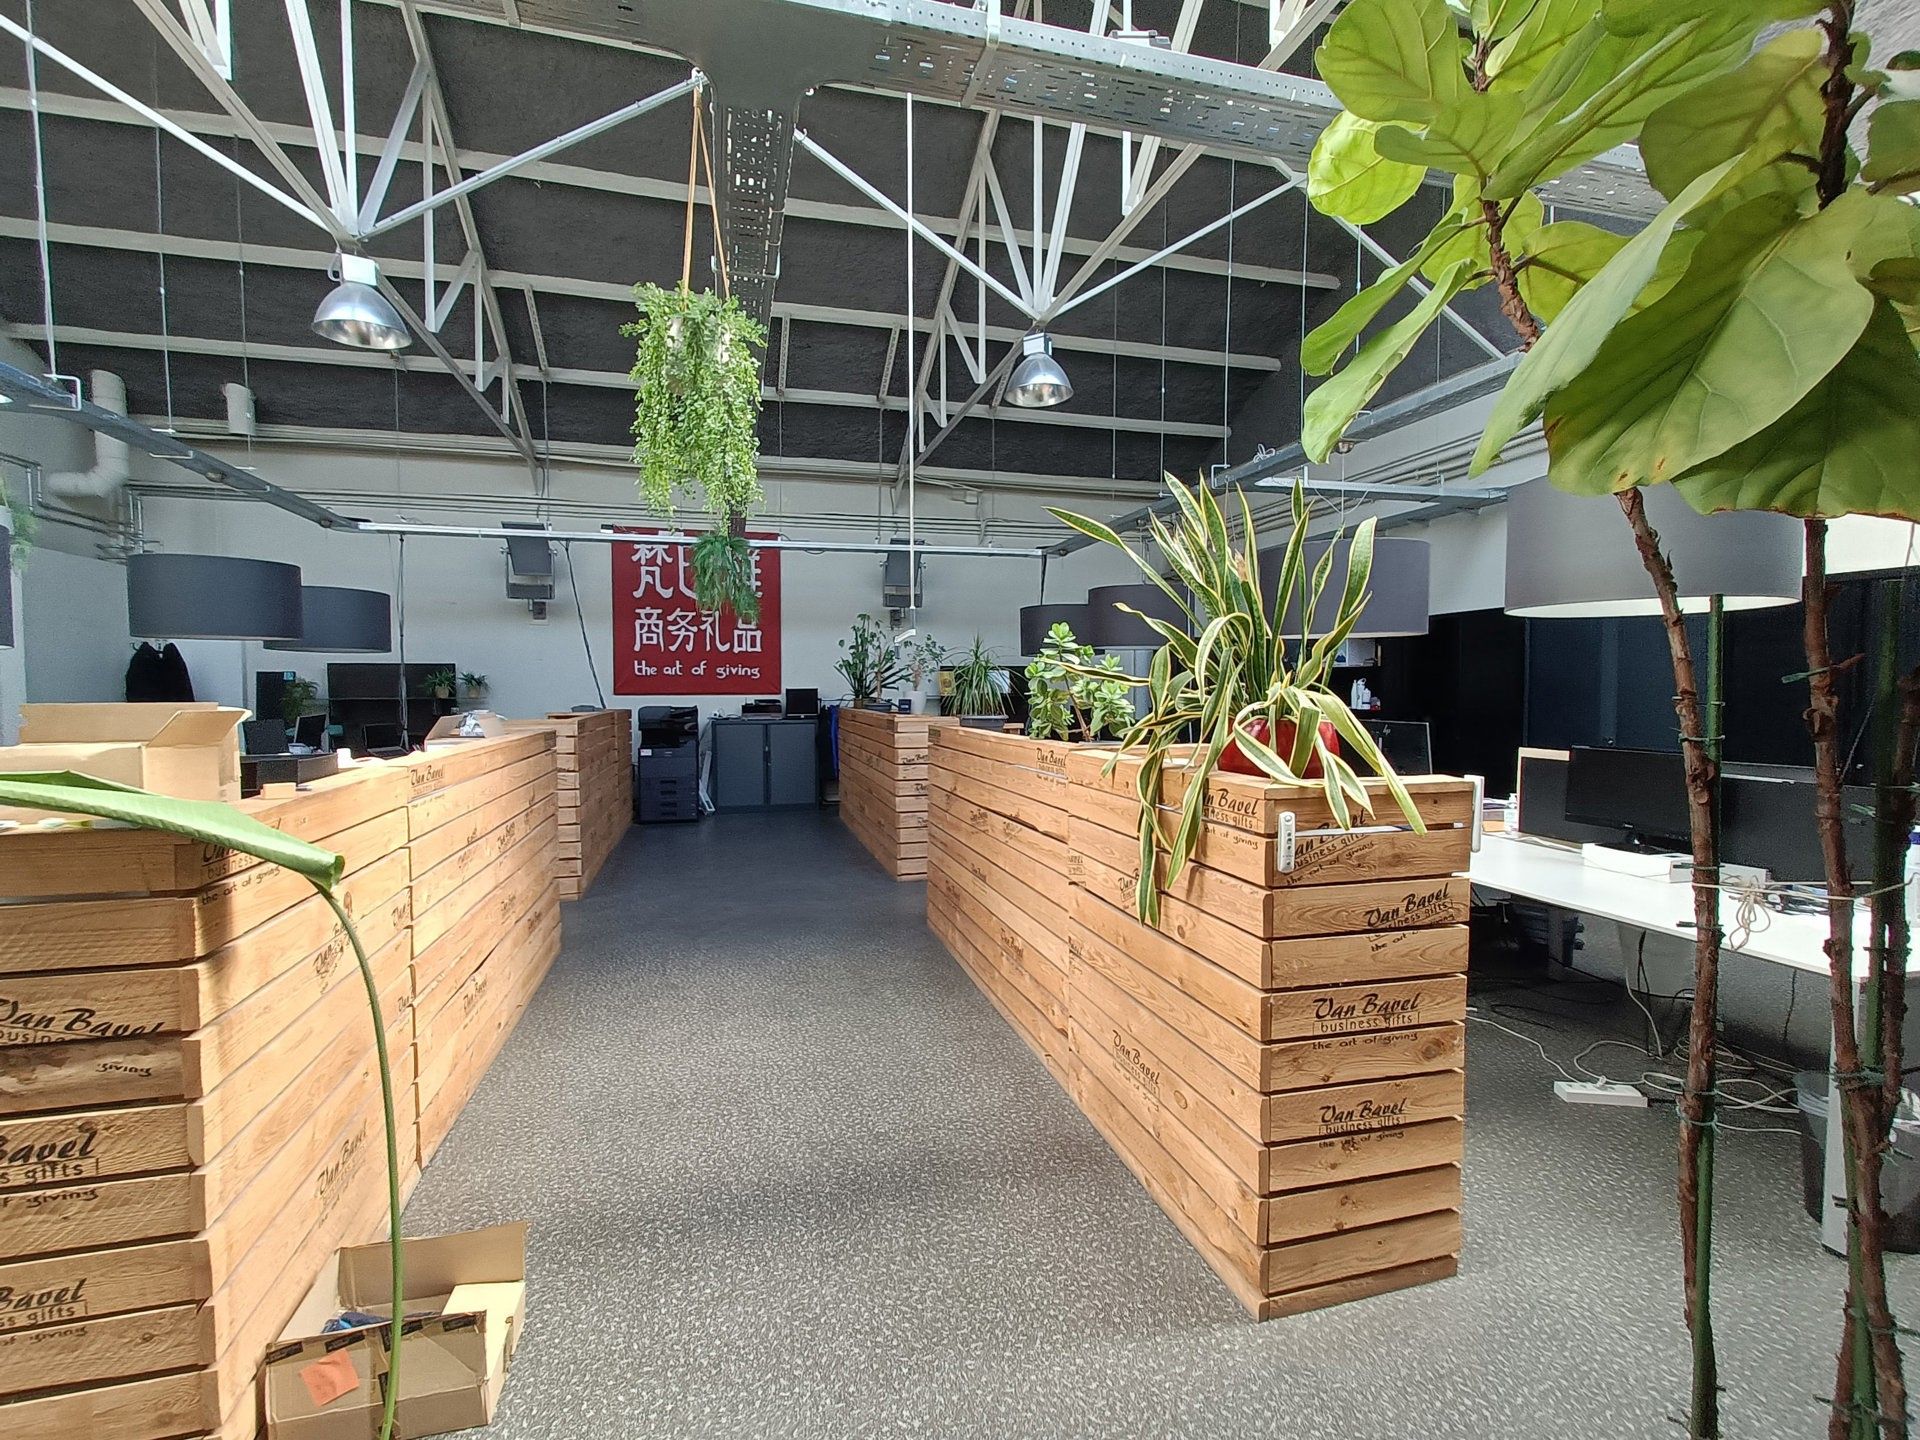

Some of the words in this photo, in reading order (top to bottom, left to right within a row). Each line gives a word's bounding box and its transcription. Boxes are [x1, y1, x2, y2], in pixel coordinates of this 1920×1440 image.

[633, 606, 762, 653] 商务礼品
[634, 659, 657, 676] the
[663, 660, 683, 675] art
[691, 660, 707, 675] of
[716, 664, 760, 679] giving
[1216, 788, 1259, 816] Bavel
[1363, 907, 1400, 927] Van
[1401, 882, 1449, 913] Bavel
[1313, 997, 1356, 1019] Van
[1360, 992, 1421, 1015] Bavel
[1321, 1017, 1379, 1033] business
[1312, 1042, 1332, 1050] the
[1339, 1038, 1357, 1047] art
[1363, 1036, 1377, 1045] of
[1383, 1032, 1418, 1045] giving
[1319, 1104, 1355, 1123] Van
[1357, 1097, 1407, 1119] Bavel
[0, 1128, 98, 1164] avel
[25, 1160, 84, 1184] gifts
[26, 1188, 99, 1209] giving
[27, 1305, 76, 1326] gifts
[28, 1326, 88, 1345] giving
